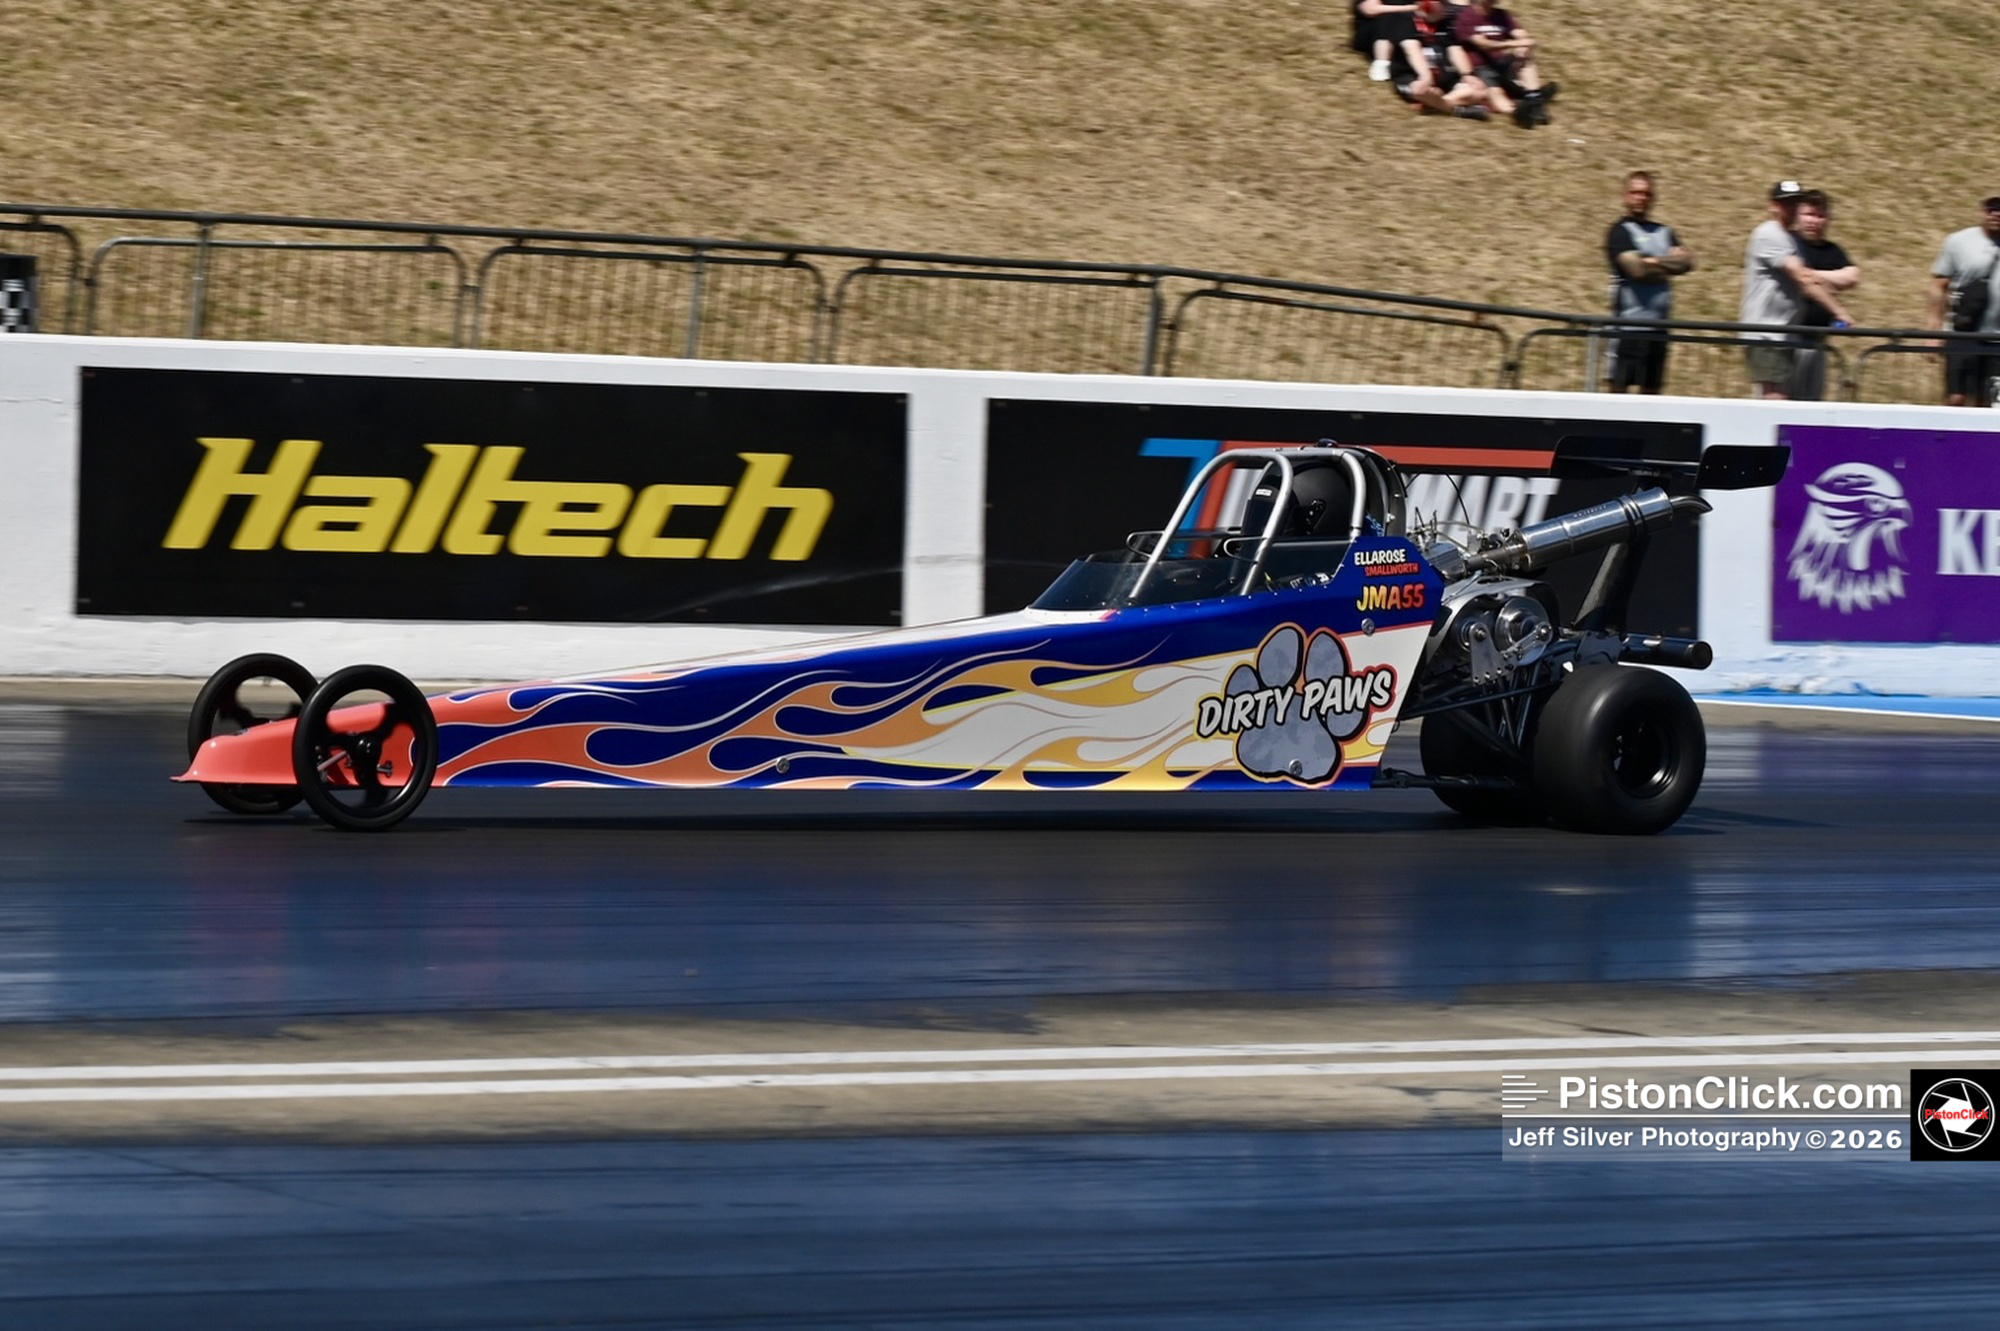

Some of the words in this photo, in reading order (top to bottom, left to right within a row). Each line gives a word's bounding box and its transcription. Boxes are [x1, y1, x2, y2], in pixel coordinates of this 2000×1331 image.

[161, 437, 834, 562] Haltech
[1354, 549, 1406, 565] ELLAROSE
[1364, 563, 1419, 576] SMALLWORTH
[1198, 686, 1294, 737] DIRTY
[1301, 670, 1392, 719] PAWS
